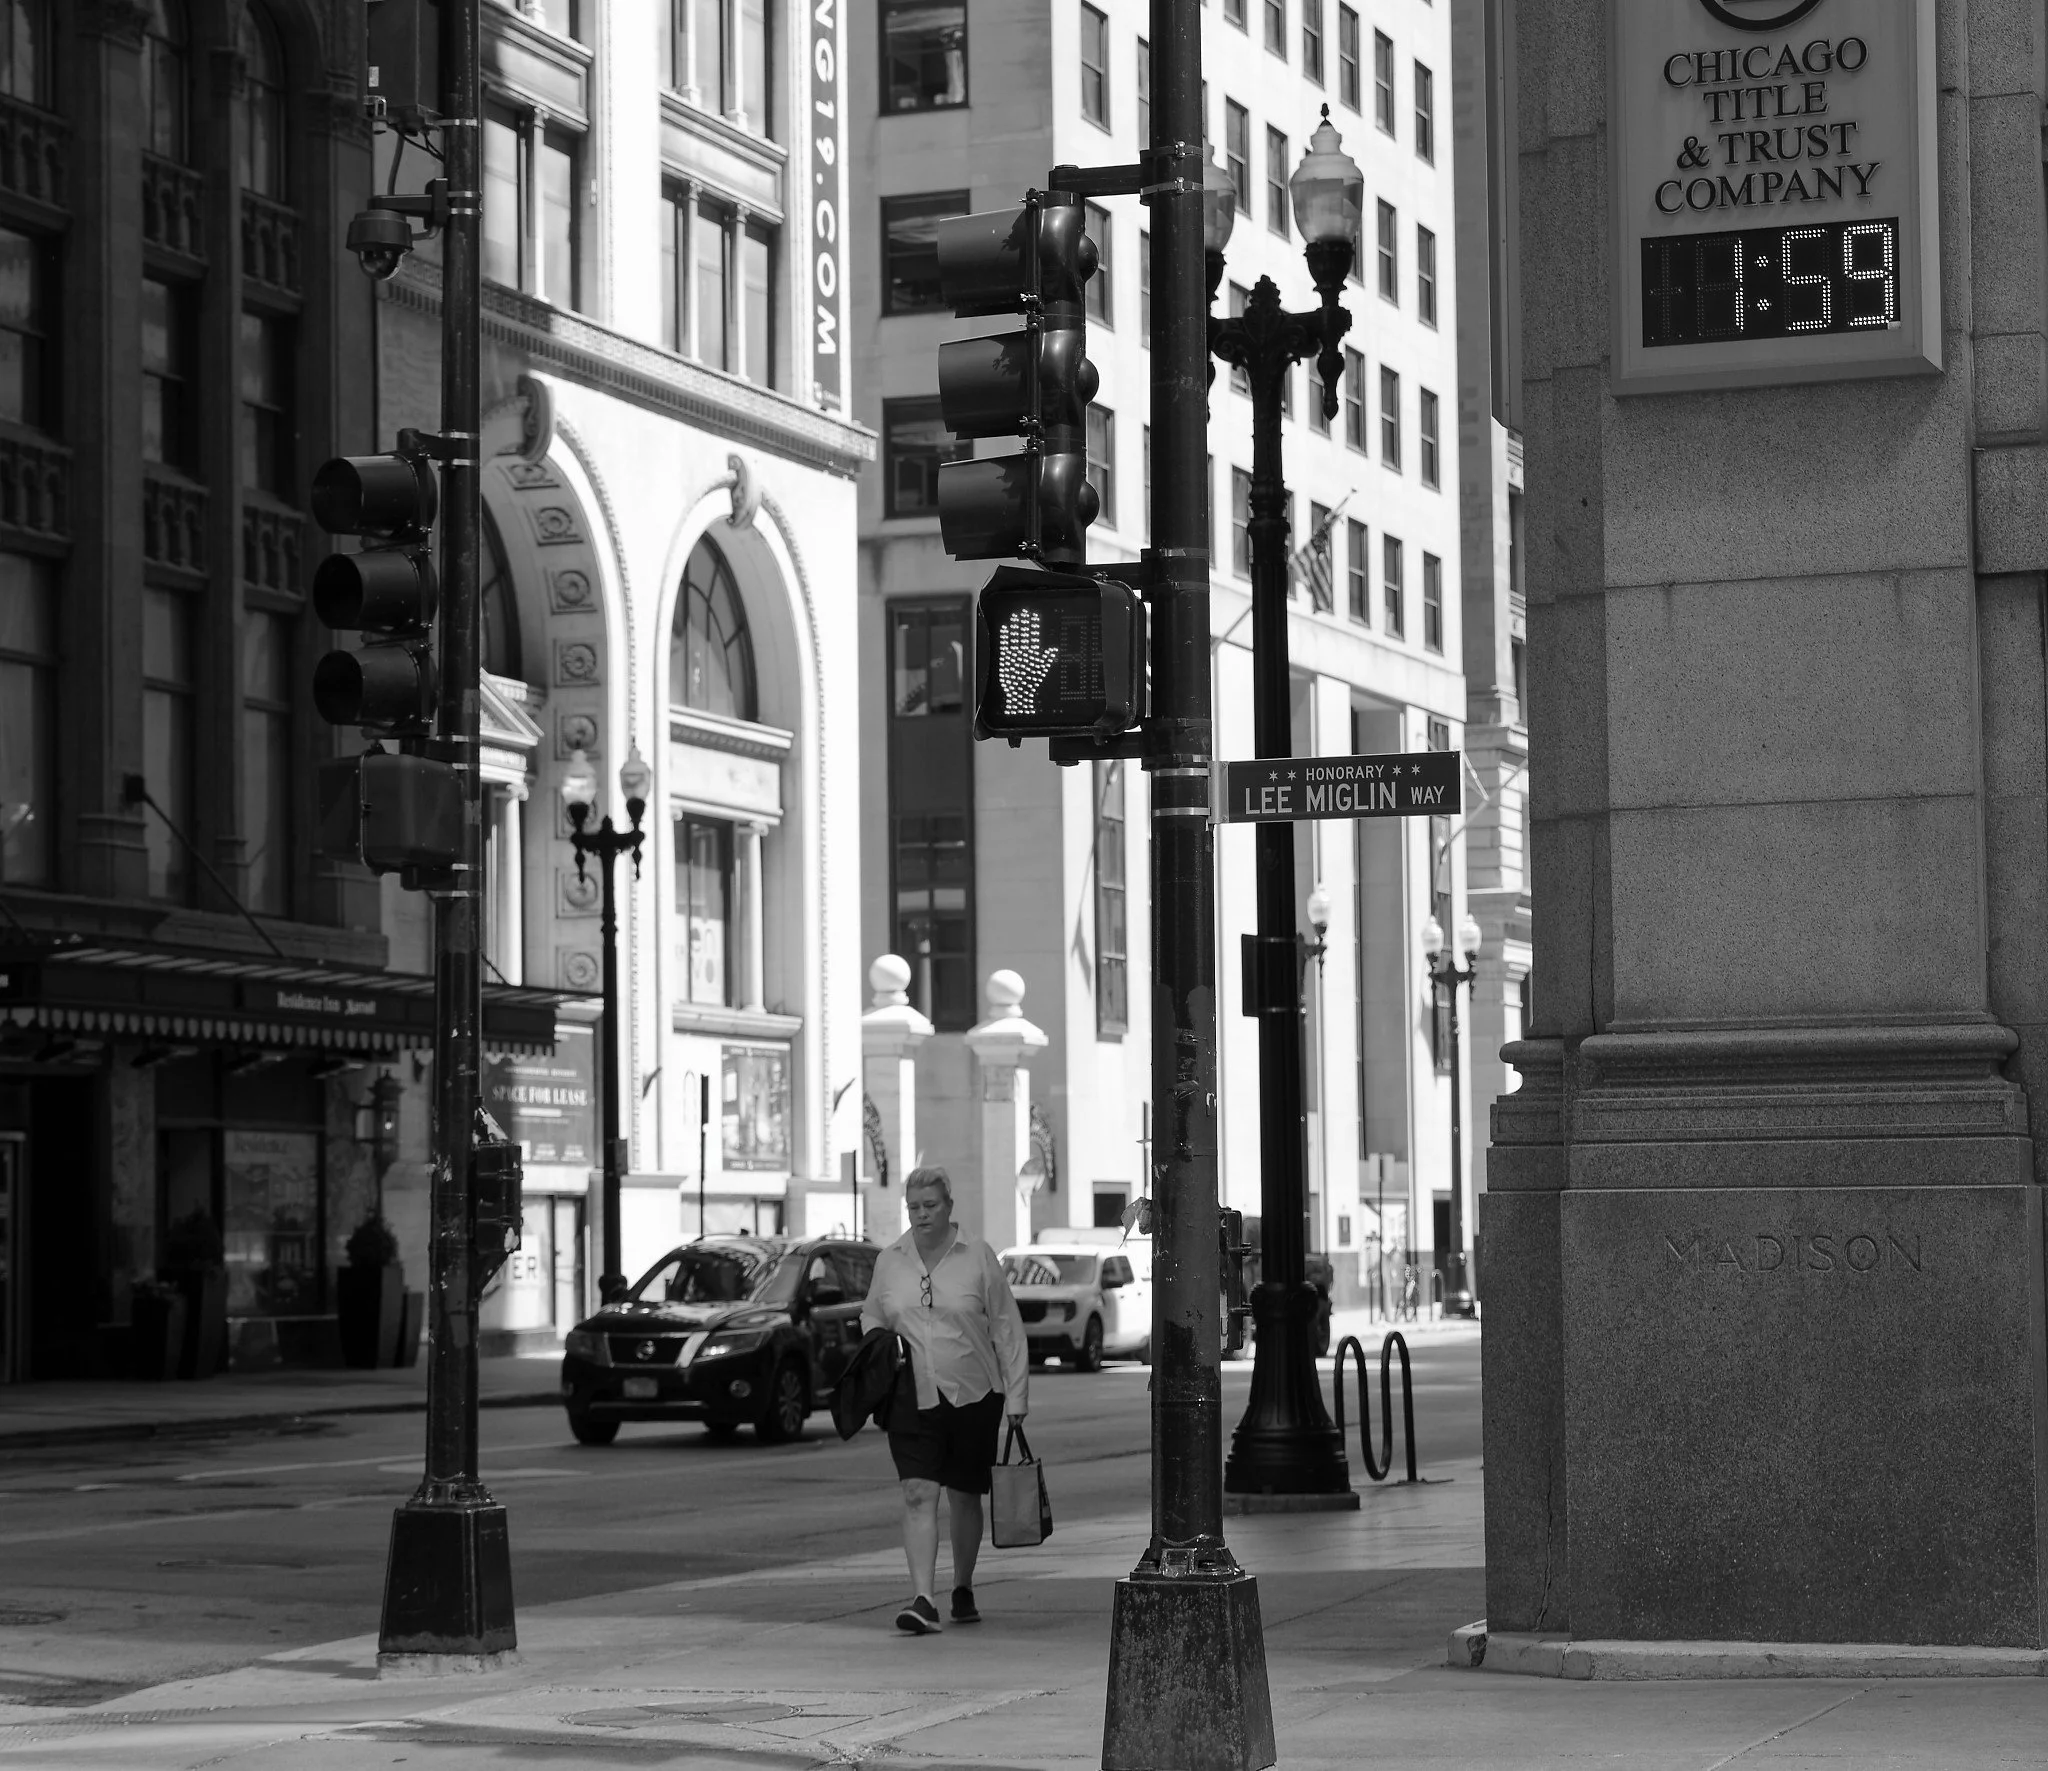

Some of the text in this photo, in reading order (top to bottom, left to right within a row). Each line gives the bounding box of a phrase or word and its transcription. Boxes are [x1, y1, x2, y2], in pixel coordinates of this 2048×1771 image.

[1663, 37, 1868, 87] CHICAGO
[1703, 81, 1829, 123] TITLE
[1676, 122, 1858, 170] & TRUST
[1655, 162, 1881, 213] COMPANY
[1734, 223, 1894, 331] 1:59
[1306, 765, 1384, 781] HONORARY
[1245, 782, 1445, 814] LEE MIGLIN WAY
[553, 1088, 588, 1106] LEASE
[1664, 1235, 1922, 1273] MADISON
